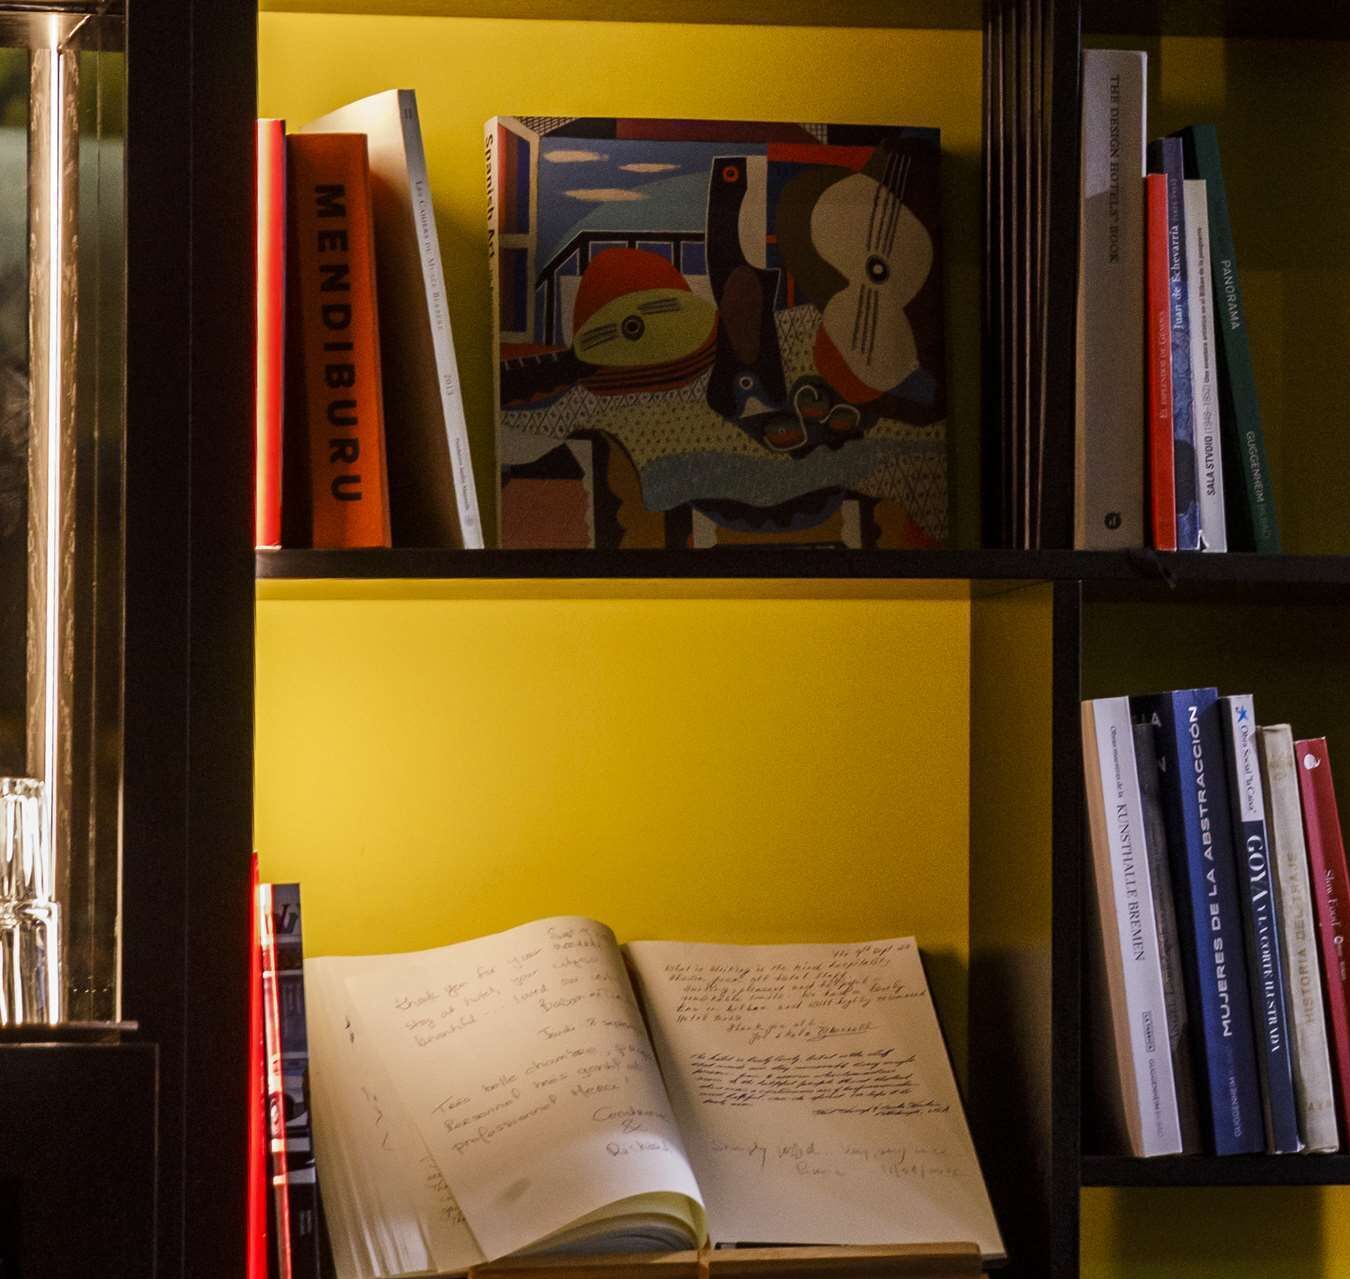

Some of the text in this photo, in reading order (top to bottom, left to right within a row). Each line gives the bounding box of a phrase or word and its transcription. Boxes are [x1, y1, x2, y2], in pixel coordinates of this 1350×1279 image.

[1110, 74, 1119, 263] THE DESIGN BOOK
[486, 229, 496, 258] Art
[1169, 224, 1181, 281] Echevarría
[1172, 288, 1181, 299] de
[1172, 304, 1183, 330] Juan
[1221, 259, 1240, 331] PANORAMA
[314, 183, 363, 503] MENDIBURU
[1203, 435, 1216, 495] SALA STVDIO
[1246, 430, 1266, 503] GUGGENHEIM
[1116, 803, 1137, 898] KUNSTHALLE
[1128, 901, 1145, 960] BREMEN
[1186, 705, 1233, 1036] MUJERES DE LA ABSTRACCIÓN
[1243, 833, 1270, 902] GOYA
[1286, 852, 1301, 902] TRAJE
[1323, 868, 1342, 927] Slow Food
[1259, 935, 1273, 979] CORTE
[1296, 947, 1314, 1024] HISTORIA
[1263, 980, 1281, 1052] ILUSTRADA
